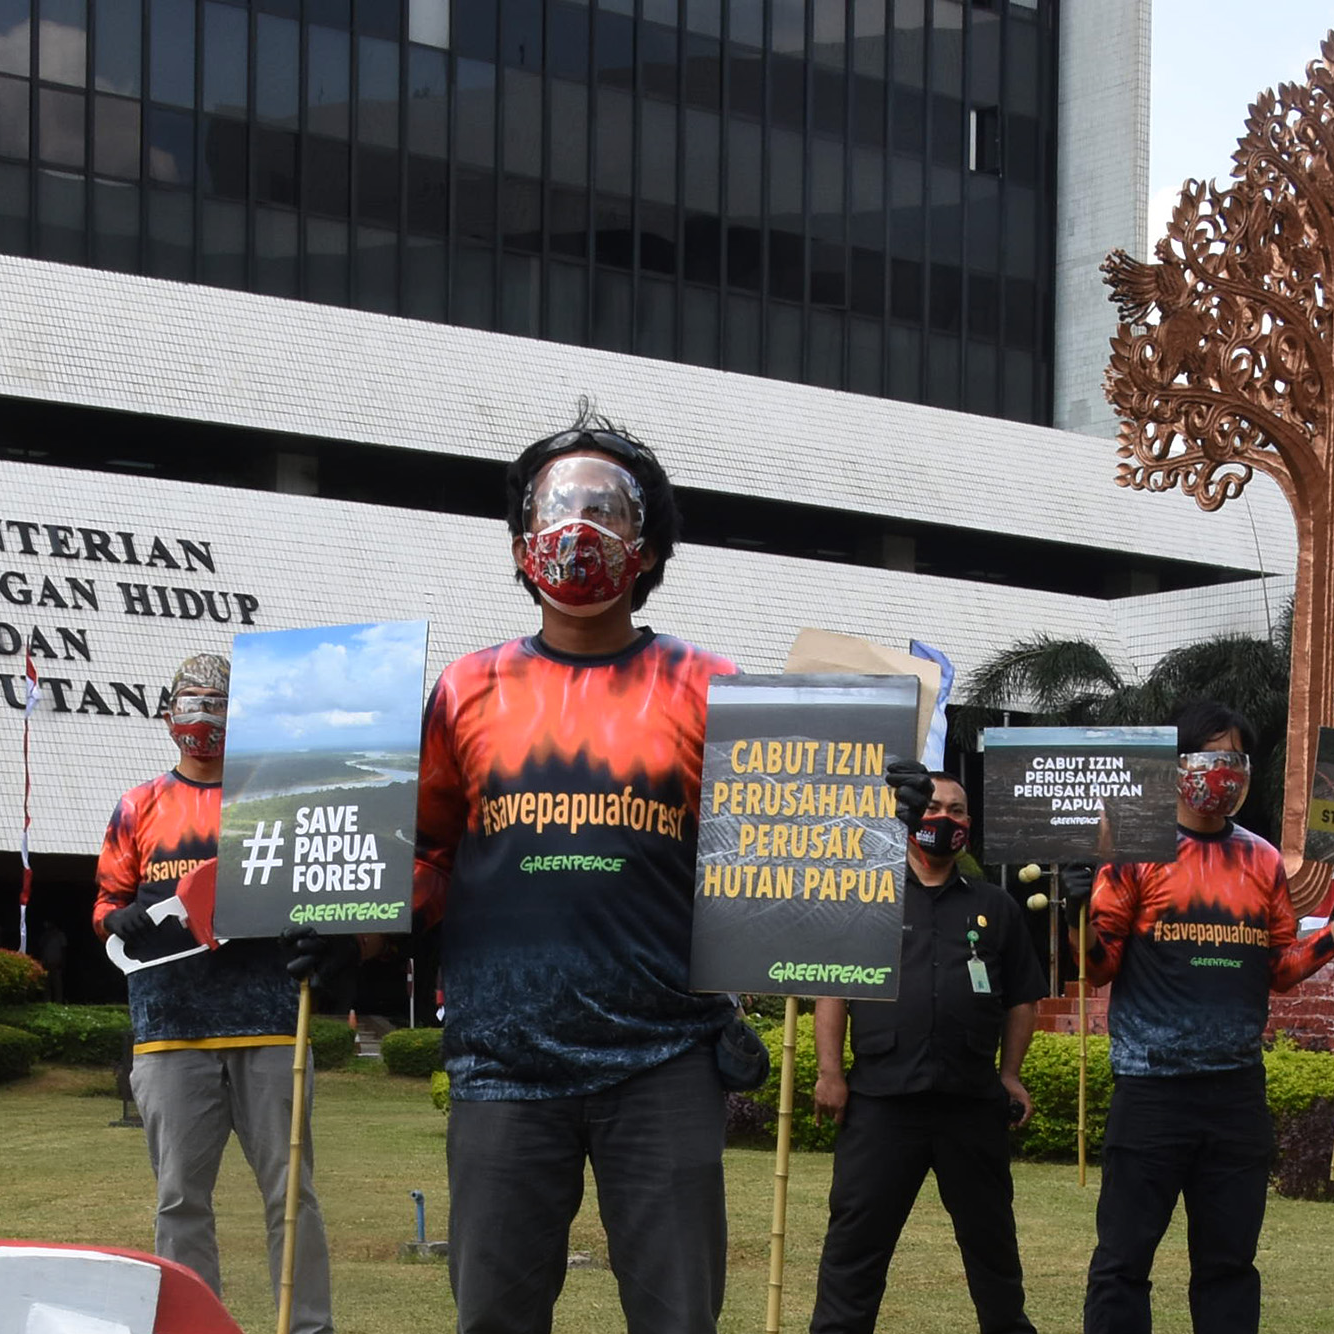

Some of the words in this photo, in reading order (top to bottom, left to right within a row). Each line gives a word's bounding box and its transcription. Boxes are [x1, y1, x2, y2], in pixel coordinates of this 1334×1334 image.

[117, 582, 260, 625] HIDUP
[731, 740, 819, 774] CABUT
[826, 742, 884, 776] IZIN
[1032, 757, 1085, 770] CABUT
[1089, 757, 1123, 770] IZIN
[1014, 785, 1085, 797] PERUSAK
[1089, 785, 1142, 797] HUTAN
[1025, 771, 1131, 783] PERUSAHAAN
[482, 786, 686, 841] #savepapuaforest
[712, 782, 897, 819] PERUSAHAAN
[1051, 799, 1105, 811] PAPUA
[295, 805, 359, 835] SAVE
[294, 834, 379, 863] PAPUA
[739, 824, 865, 860] PERUSAK
[292, 863, 386, 893] FOREST
[520, 855, 626, 874] GREENPEACE
[704, 865, 794, 899] HUTAN
[803, 867, 896, 903] PAPUA
[289, 901, 405, 925] GREENPEACE
[768, 961, 892, 984] GREENPEACE
[1190, 957, 1243, 968] GREENPEACE
